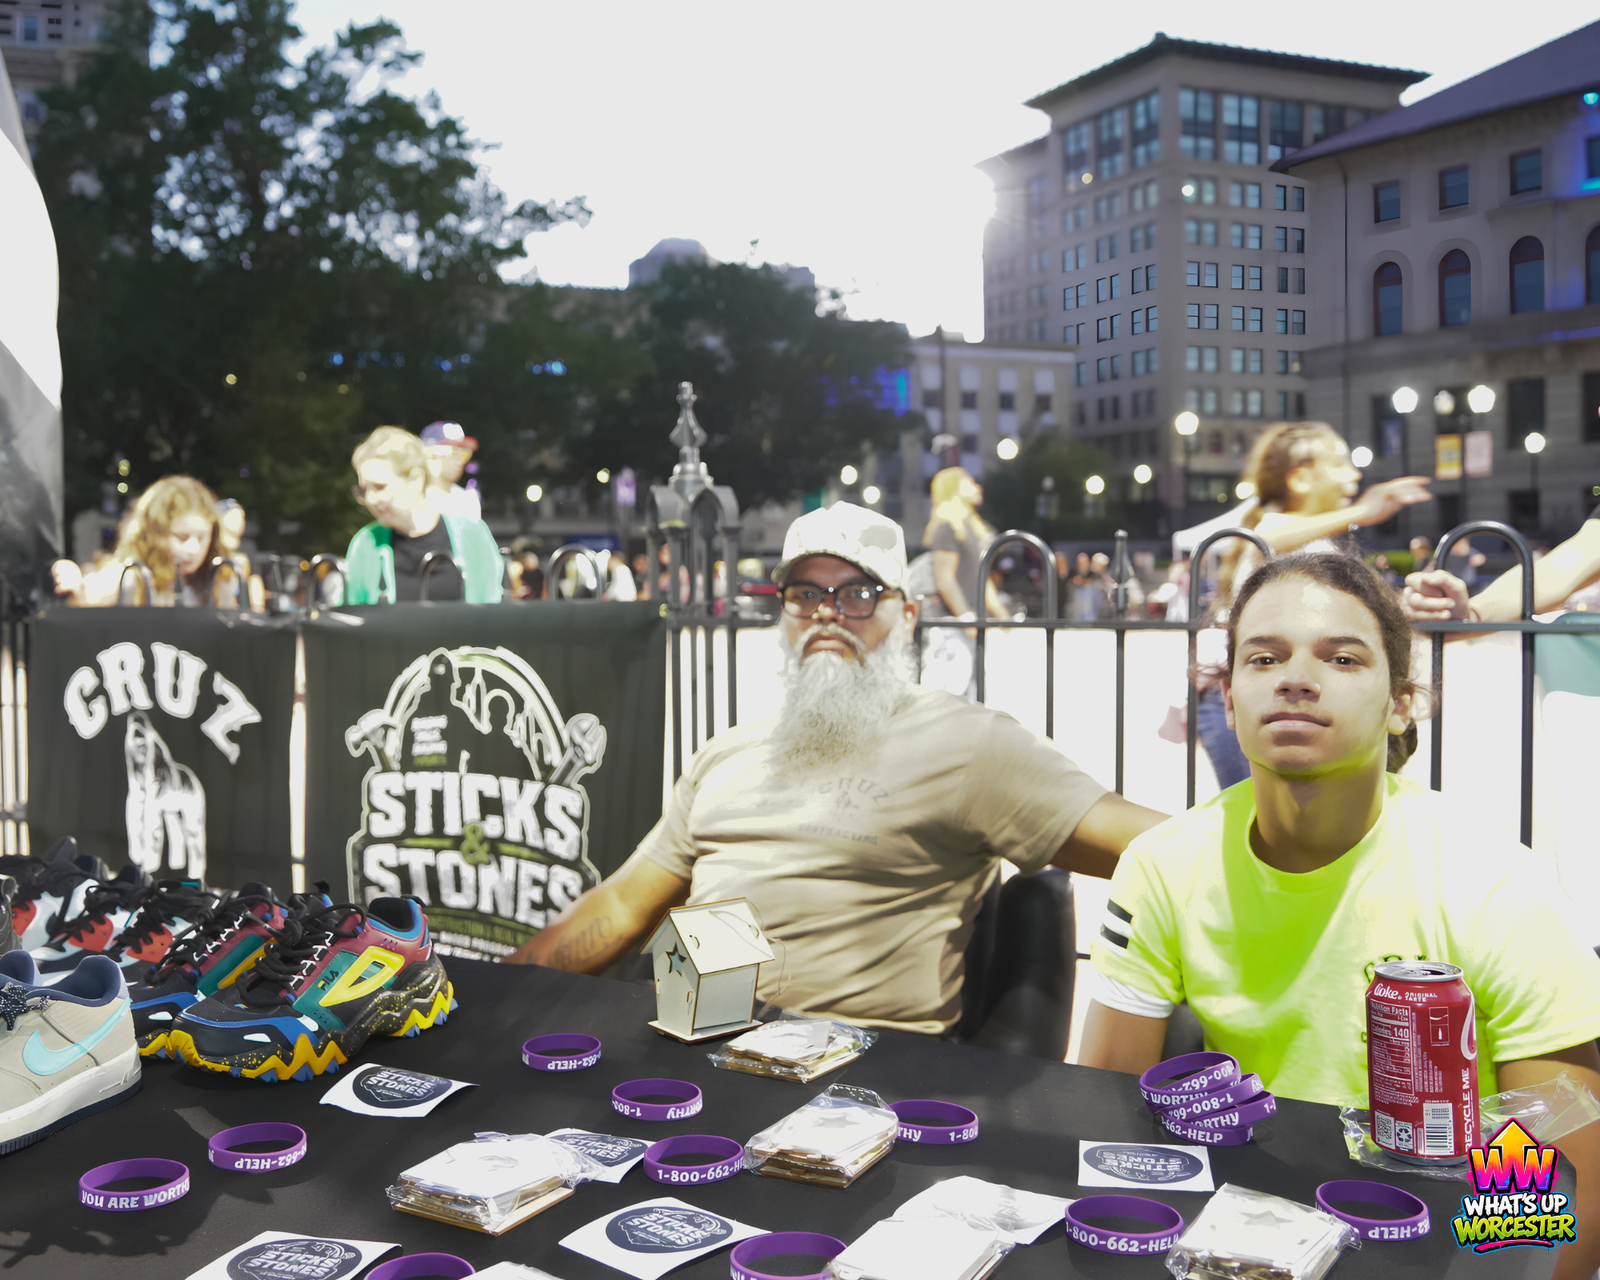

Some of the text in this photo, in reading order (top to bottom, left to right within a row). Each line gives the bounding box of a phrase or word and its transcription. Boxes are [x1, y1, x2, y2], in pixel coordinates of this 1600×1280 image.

[64, 641, 262, 765] CRUZ
[369, 771, 583, 861] STICKS
[461, 823, 491, 865] &
[364, 843, 583, 930] STONES
[318, 969, 340, 992] FILA
[1393, 1027, 1409, 1039] 140
[366, 1077, 428, 1097] STONES
[376, 1070, 436, 1090] STICKS
[1461, 1067, 1470, 1090] ME
[1462, 1091, 1473, 1152] RECYCLE
[81, 1190, 104, 1207] YOU
[107, 1196, 140, 1209] ARE
[625, 1217, 695, 1245] STONES
[643, 1212, 710, 1240] STICKS
[245, 1257, 331, 1278] STONES
[261, 1250, 342, 1268] STICKS
